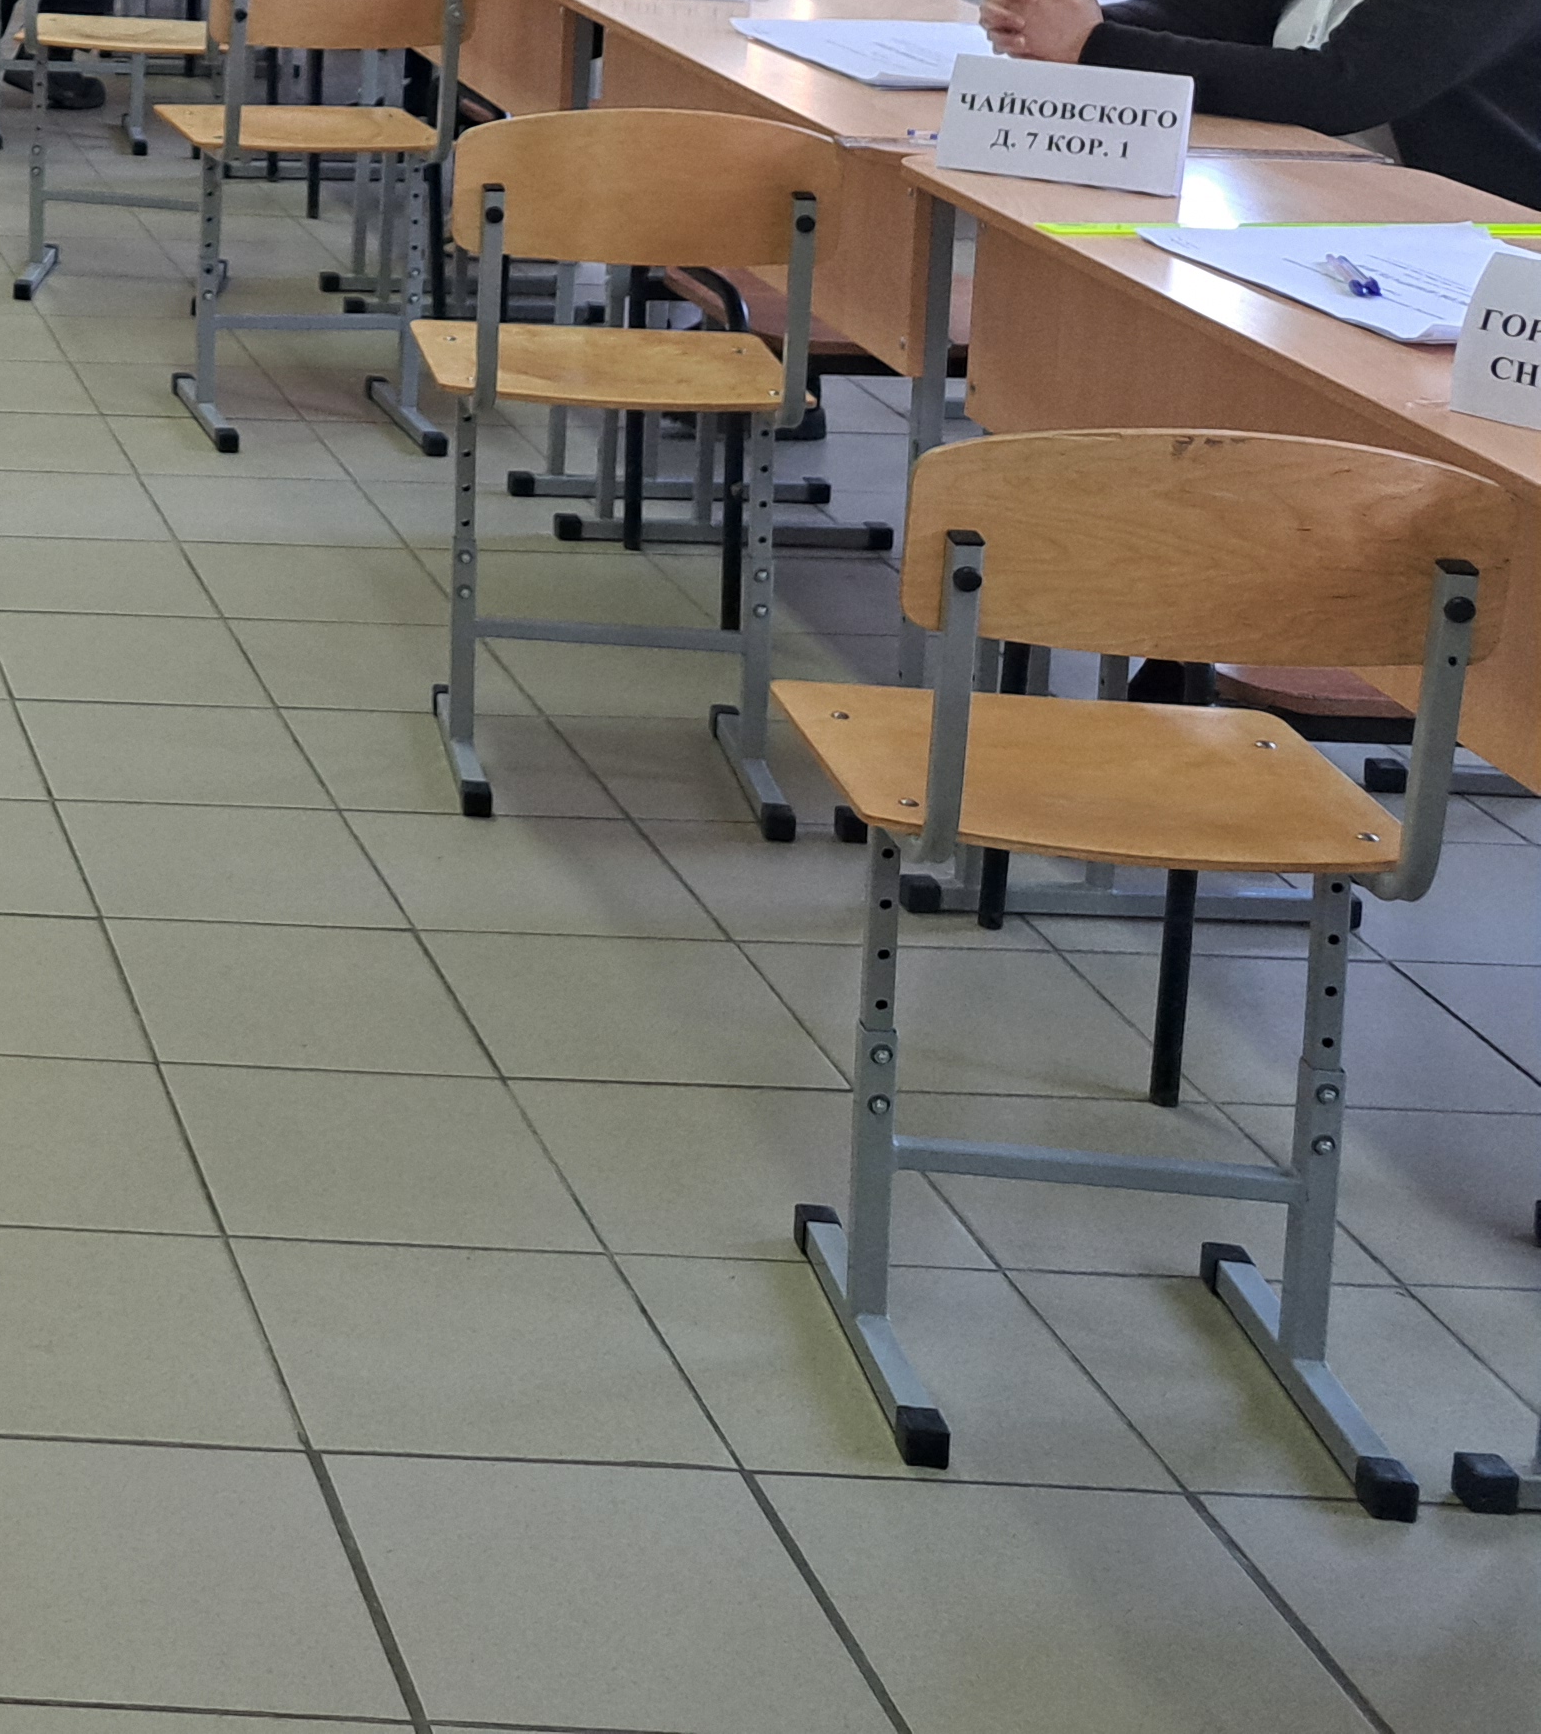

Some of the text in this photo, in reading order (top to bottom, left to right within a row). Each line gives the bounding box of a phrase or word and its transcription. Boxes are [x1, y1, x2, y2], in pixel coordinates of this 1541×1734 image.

[960, 92, 1178, 129] ЧАЙКОВСКОГО
[989, 128, 1129, 159] Д. 7 КОР. 1
